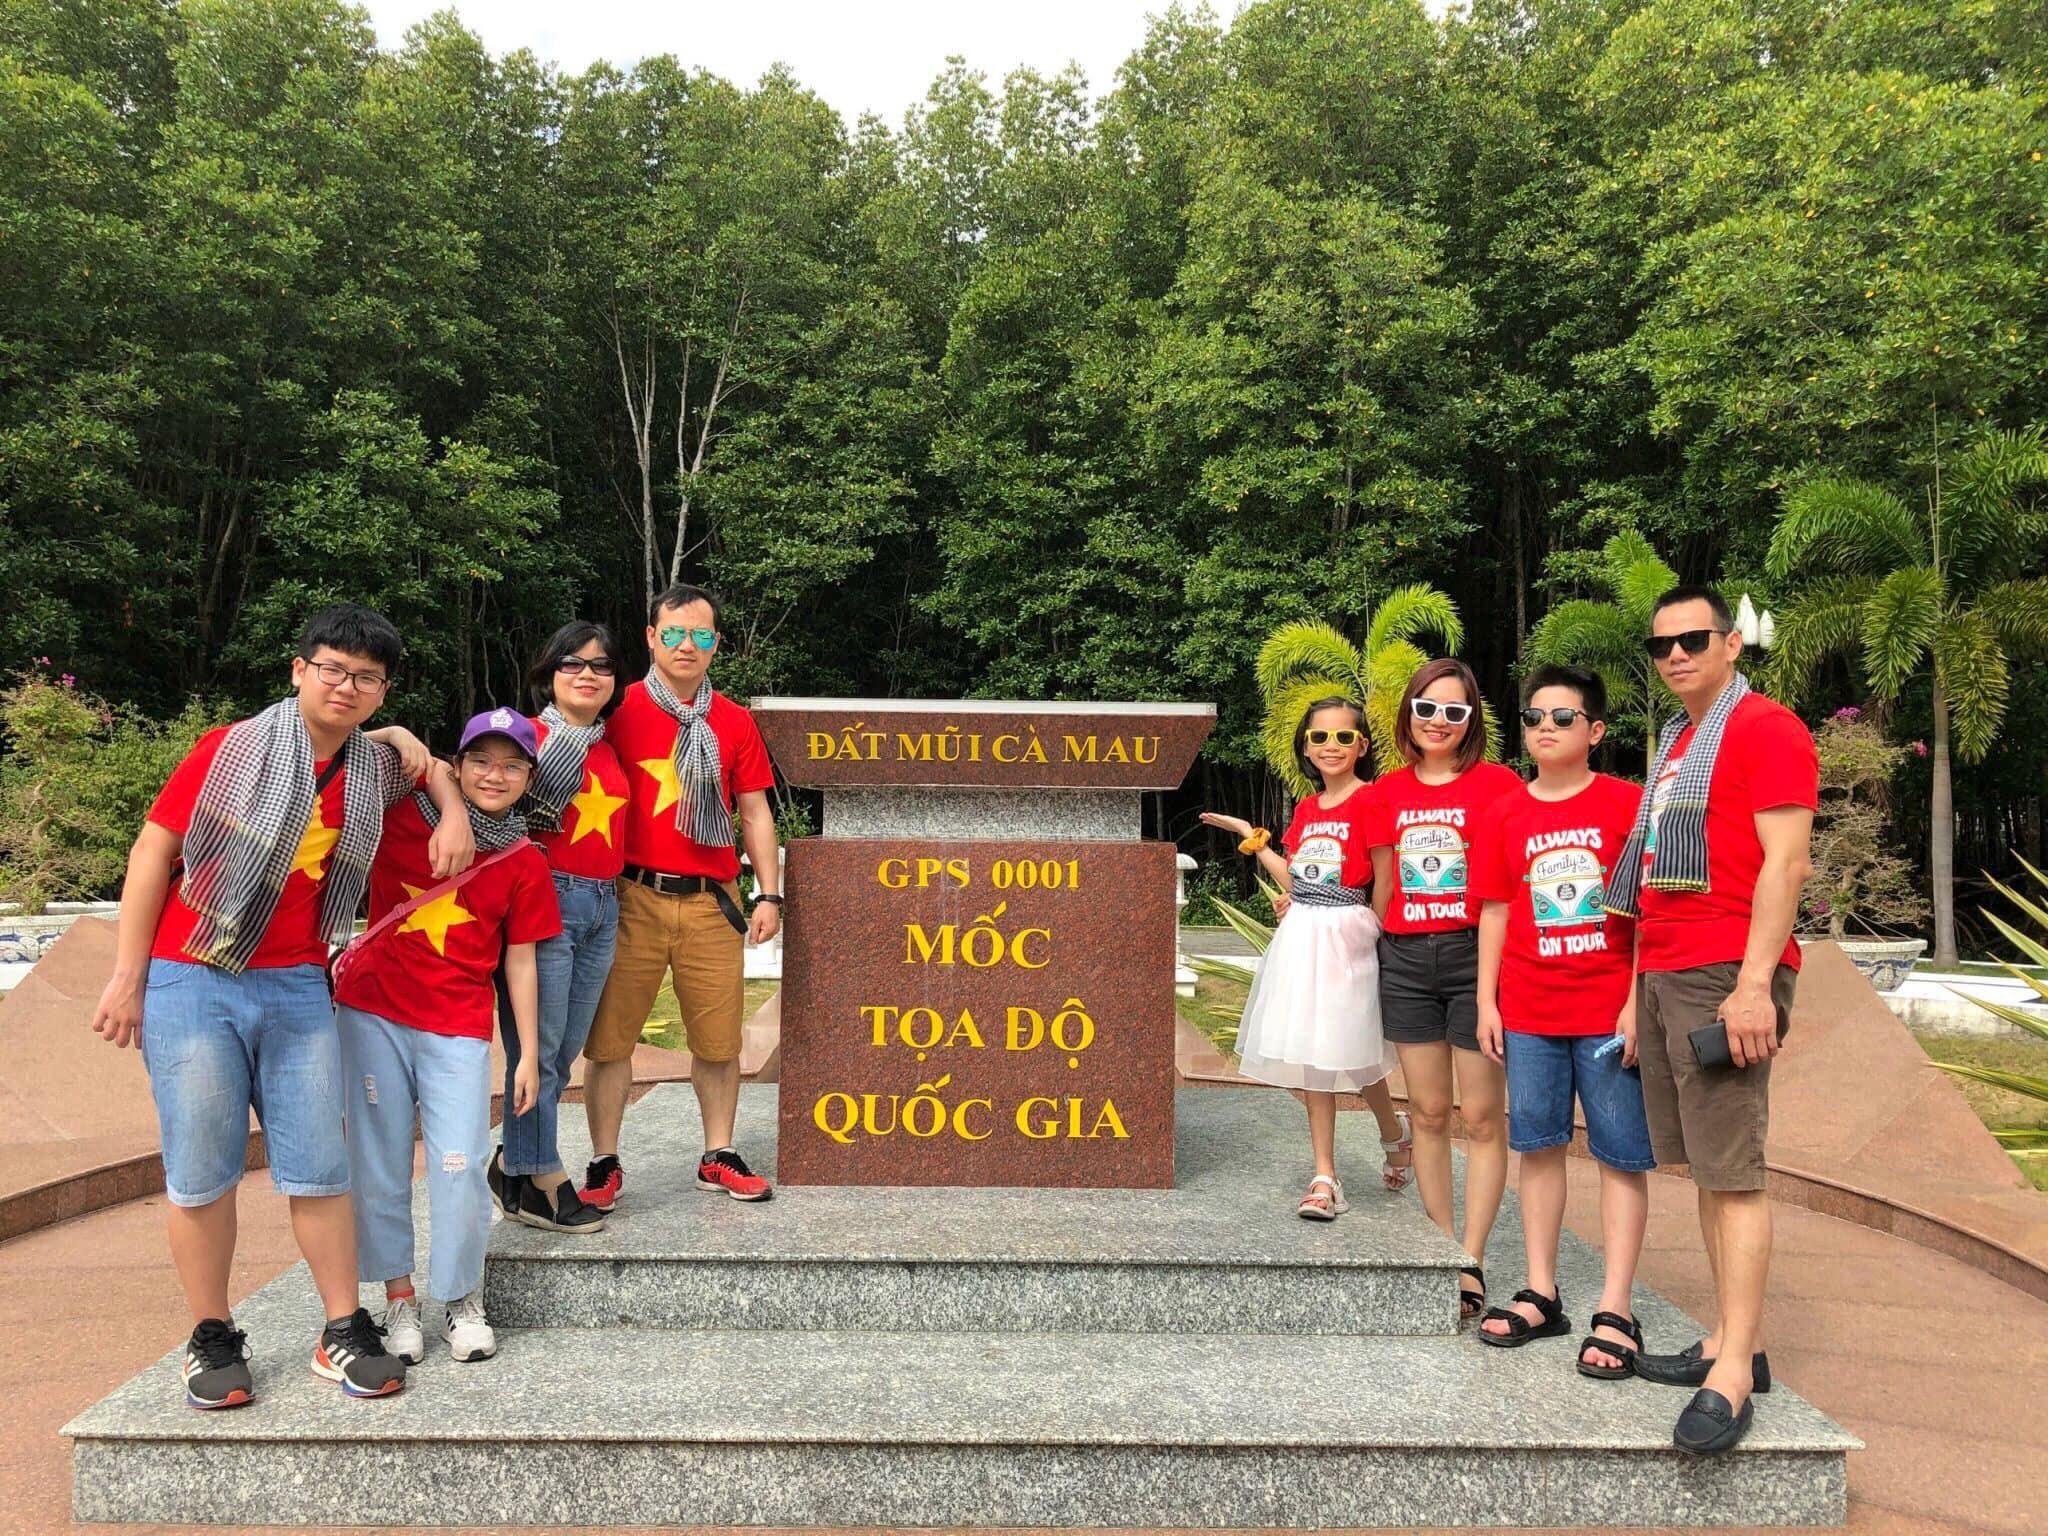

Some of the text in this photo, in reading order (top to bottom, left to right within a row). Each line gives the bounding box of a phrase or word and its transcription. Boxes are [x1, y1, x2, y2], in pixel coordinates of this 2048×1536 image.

[806, 722, 1161, 765] ĐẤT MŨI CÀ MAU
[1300, 821, 1350, 842] ALWAYS
[1397, 809, 1465, 829] ALWAYS
[1405, 829, 1452, 849] Family's
[1525, 828, 1602, 859] ALWAYS
[877, 858, 1081, 890] GPS 0001
[1536, 853, 1587, 880] Family's
[1404, 902, 1467, 920] ON TOUR
[901, 901, 1051, 969] MỐC
[1538, 931, 1609, 957] ON TOUR
[860, 998, 1095, 1069] TỌA ĐỘ
[813, 1073, 1131, 1145] QUỐC GIA
